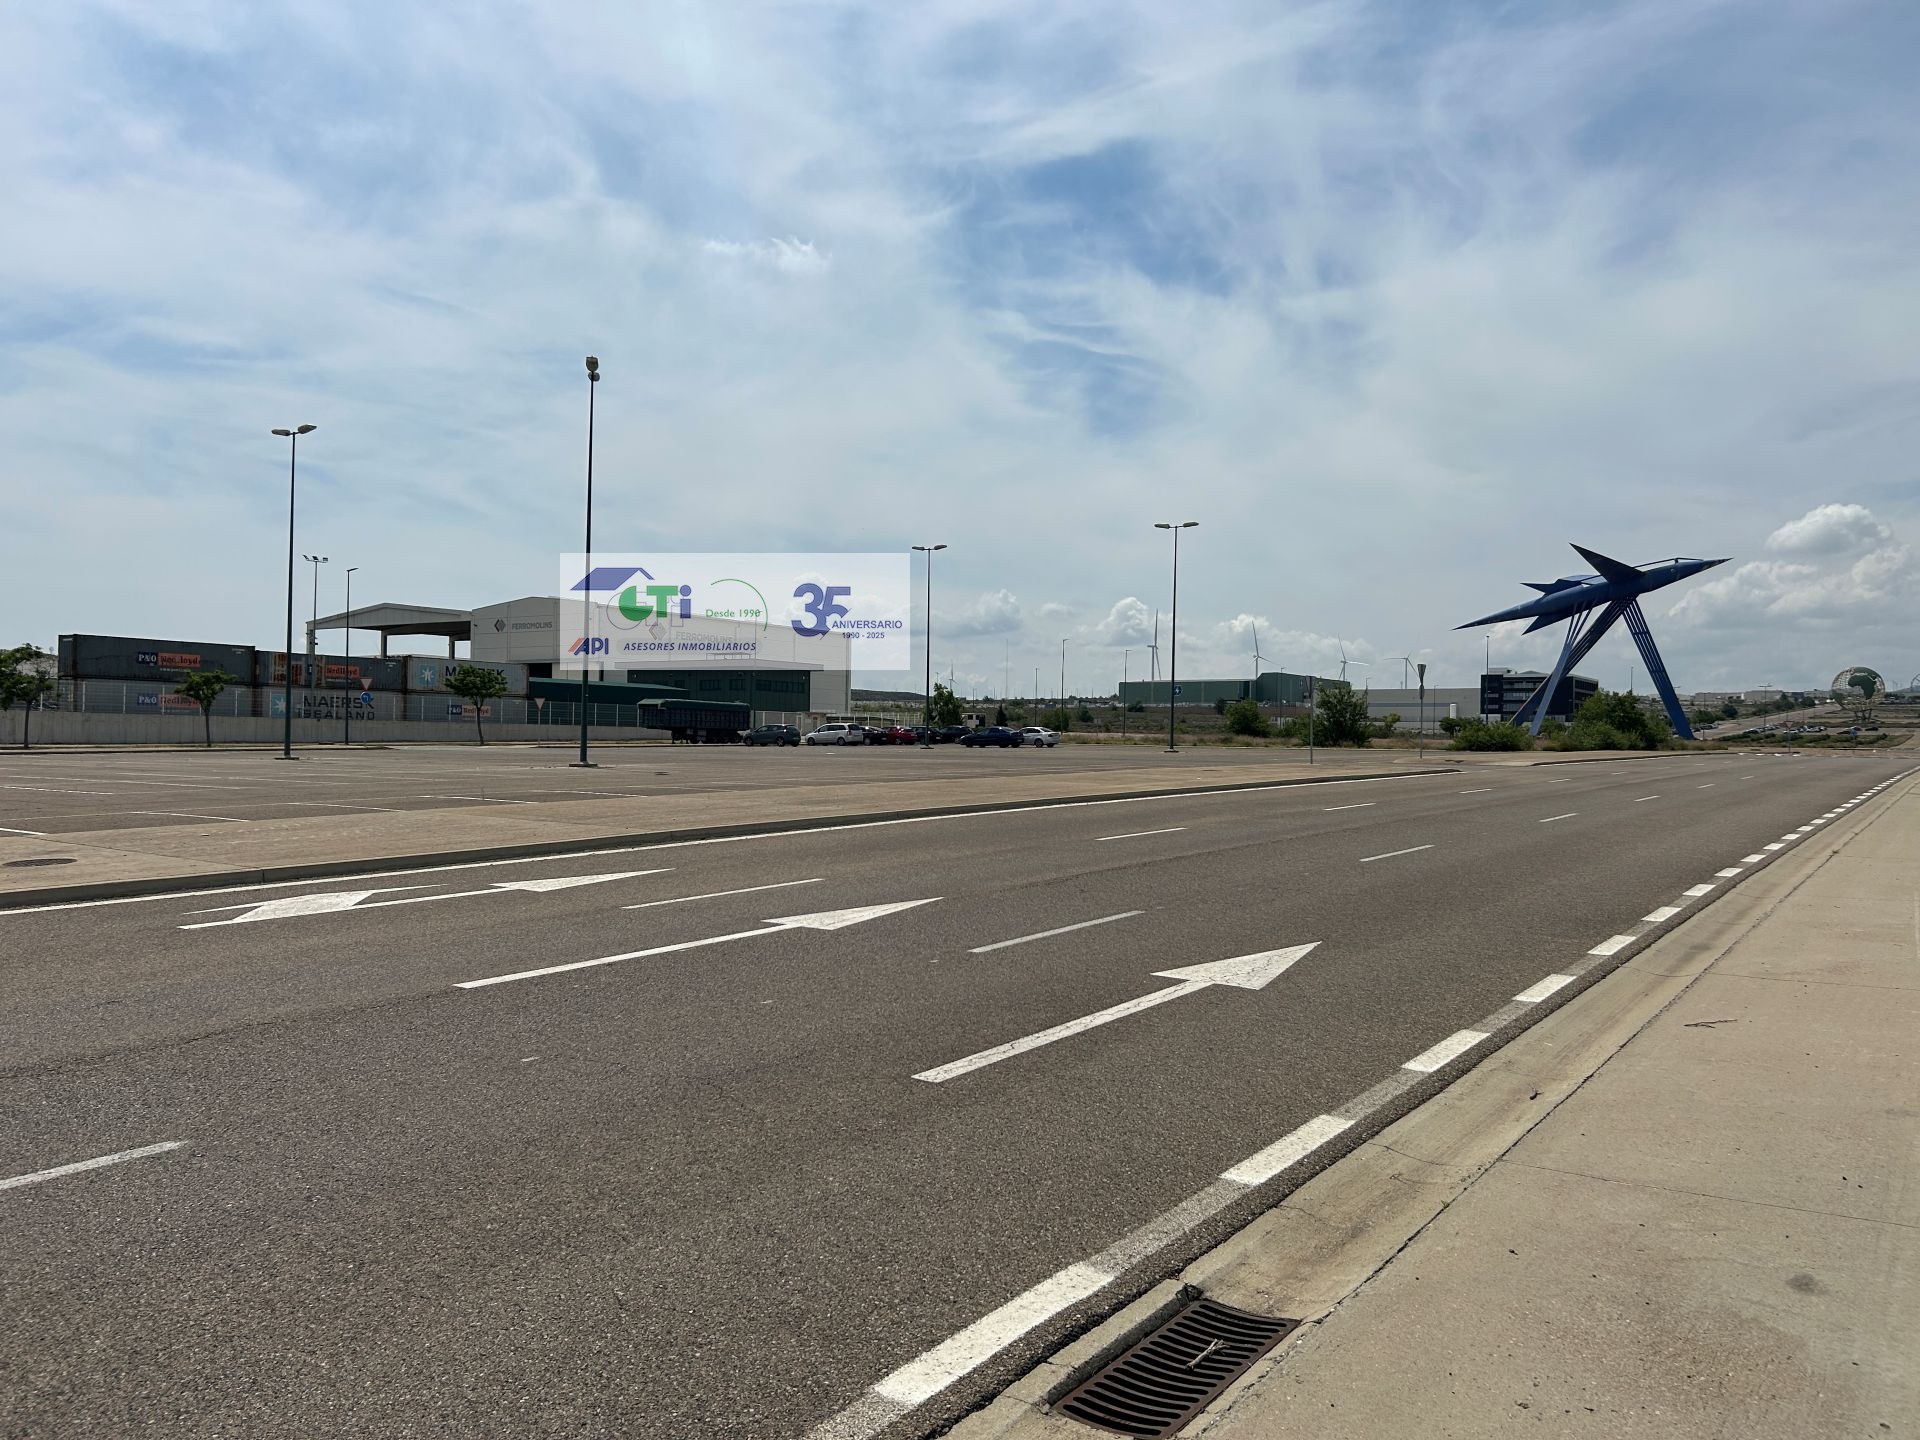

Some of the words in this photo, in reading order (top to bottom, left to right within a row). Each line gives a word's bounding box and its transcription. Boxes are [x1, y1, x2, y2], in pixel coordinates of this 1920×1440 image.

[512, 621, 552, 630] FERROMOLINS
[675, 631, 734, 643] FERROMOLINS
[138, 654, 157, 662] P&O
[138, 696, 157, 704] P&O
